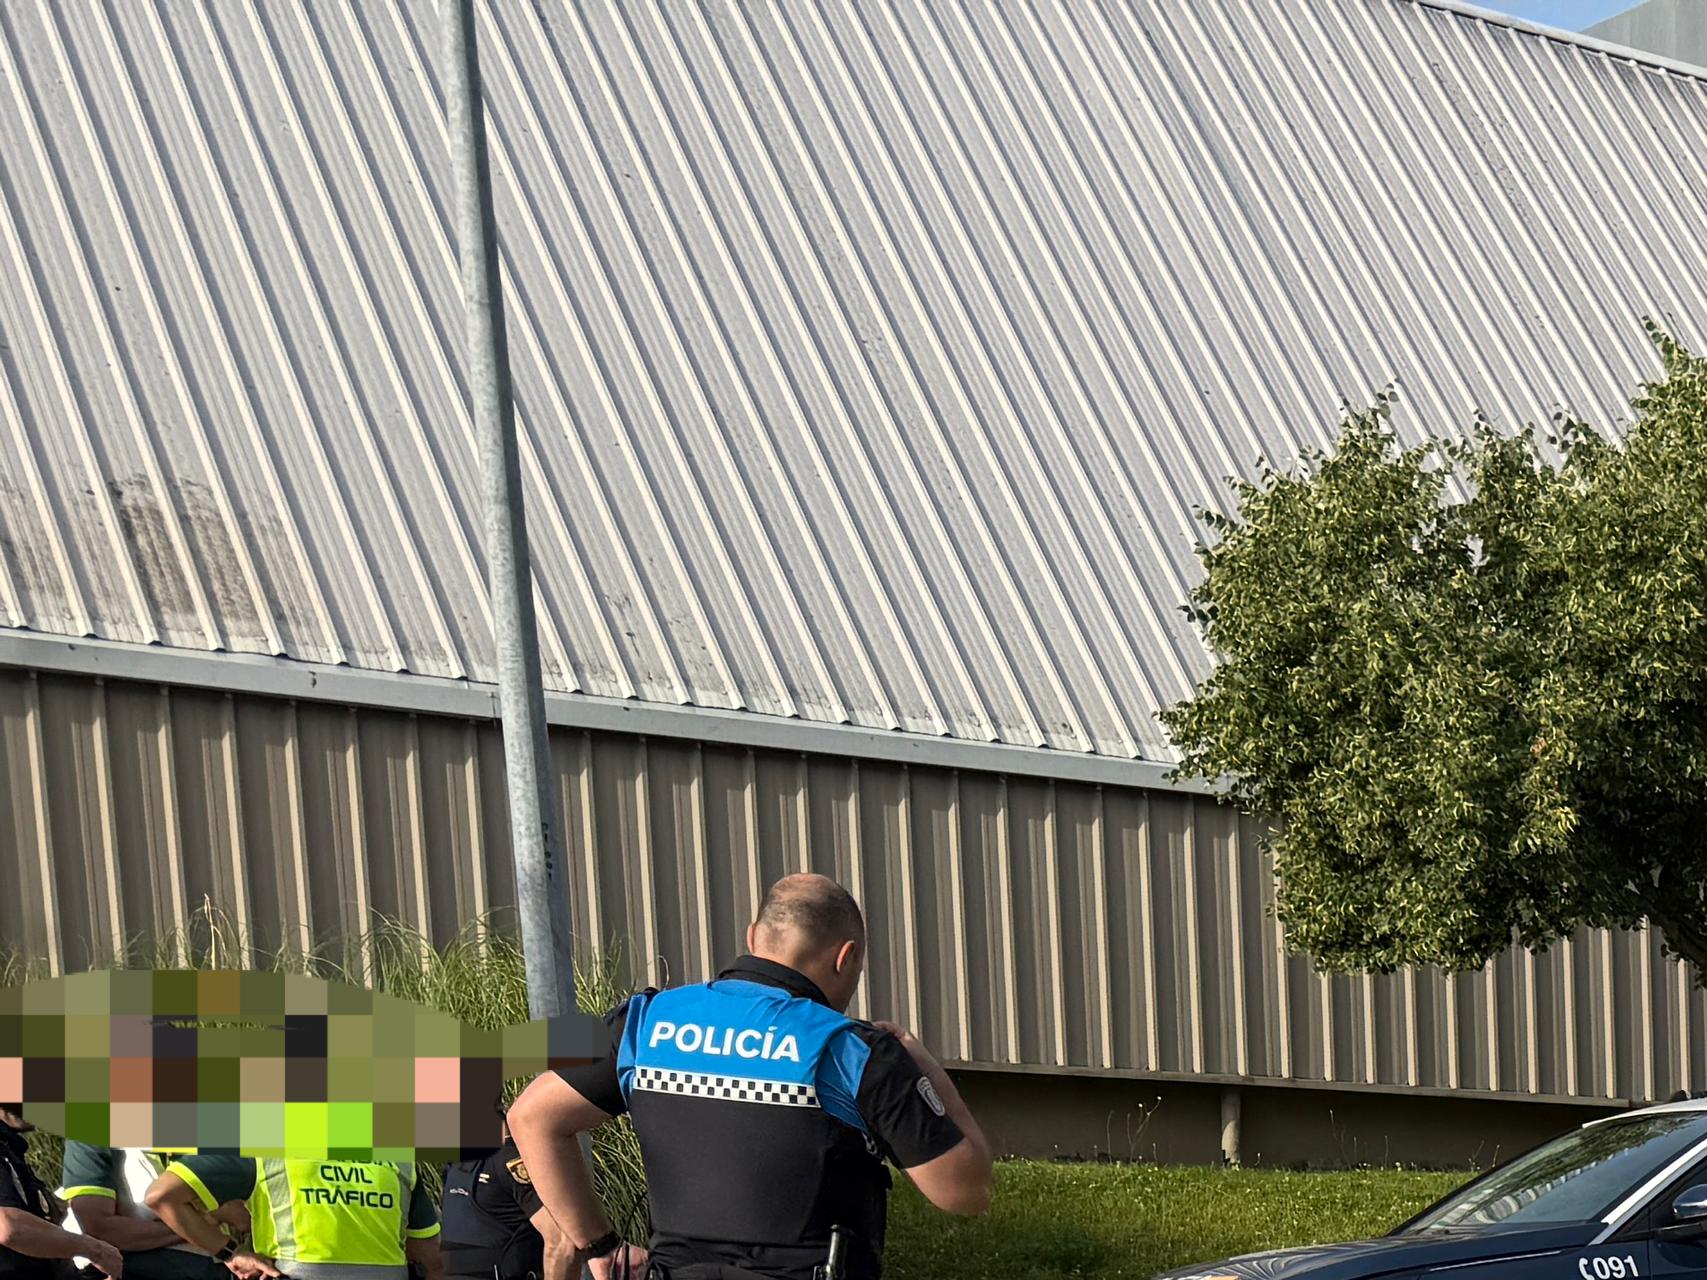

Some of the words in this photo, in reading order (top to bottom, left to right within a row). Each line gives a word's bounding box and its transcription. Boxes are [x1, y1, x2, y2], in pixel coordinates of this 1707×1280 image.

[649, 1021, 800, 1063] POLICÍA
[320, 1164, 373, 1184] CIVIL
[300, 1185, 394, 1210] TRÁFICO
[1592, 1255, 1639, 1280] 091
